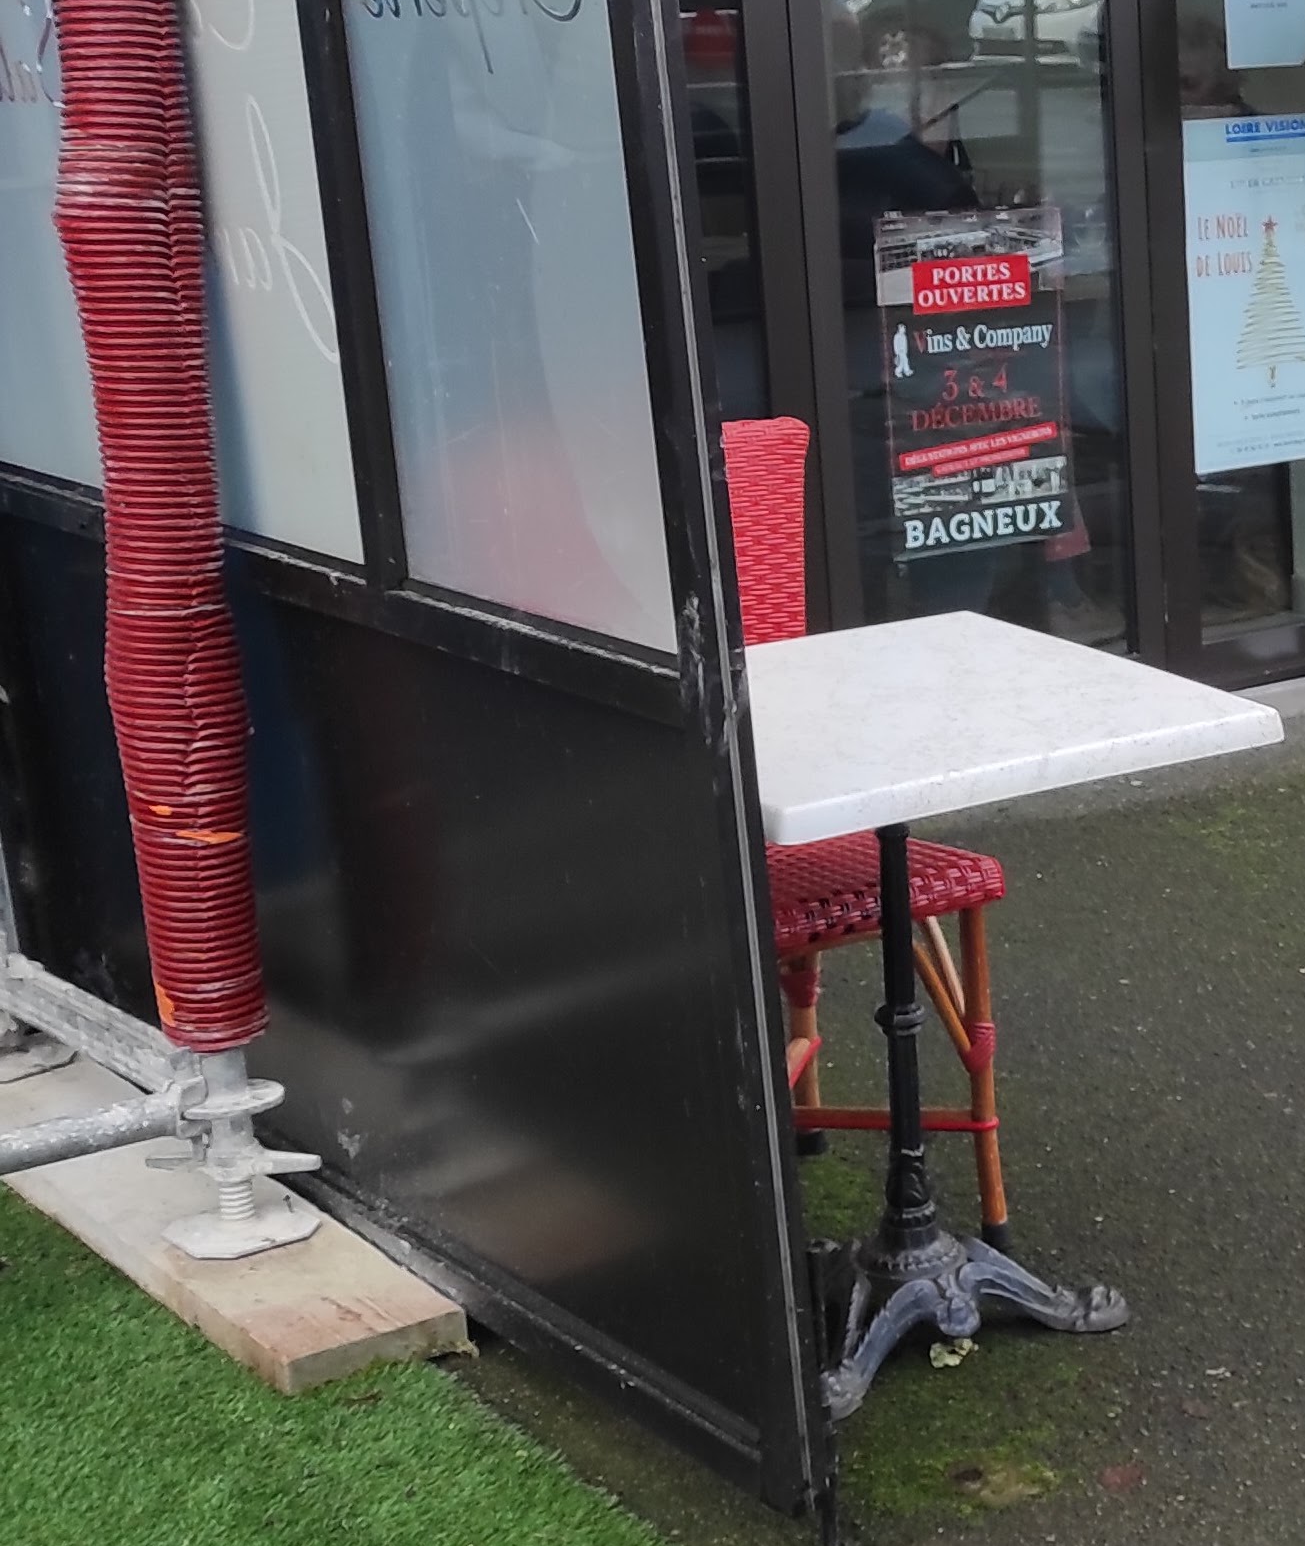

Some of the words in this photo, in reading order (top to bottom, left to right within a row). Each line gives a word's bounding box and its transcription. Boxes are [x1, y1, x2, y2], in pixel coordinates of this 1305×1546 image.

[1225, 120, 1261, 135] LOIRE
[932, 261, 1011, 286] PORTES
[1217, 252, 1252, 276] LOUIS
[917, 281, 1027, 308] OUVERTES
[913, 327, 953, 354] Vins
[955, 325, 972, 351] &
[973, 323, 1053, 352] Company
[942, 369, 959, 402] 3
[968, 375, 985, 398] &
[992, 362, 1009, 394] 4
[911, 396, 1043, 432] DÉCEMBRE
[904, 501, 1063, 550] BAGNEUX
